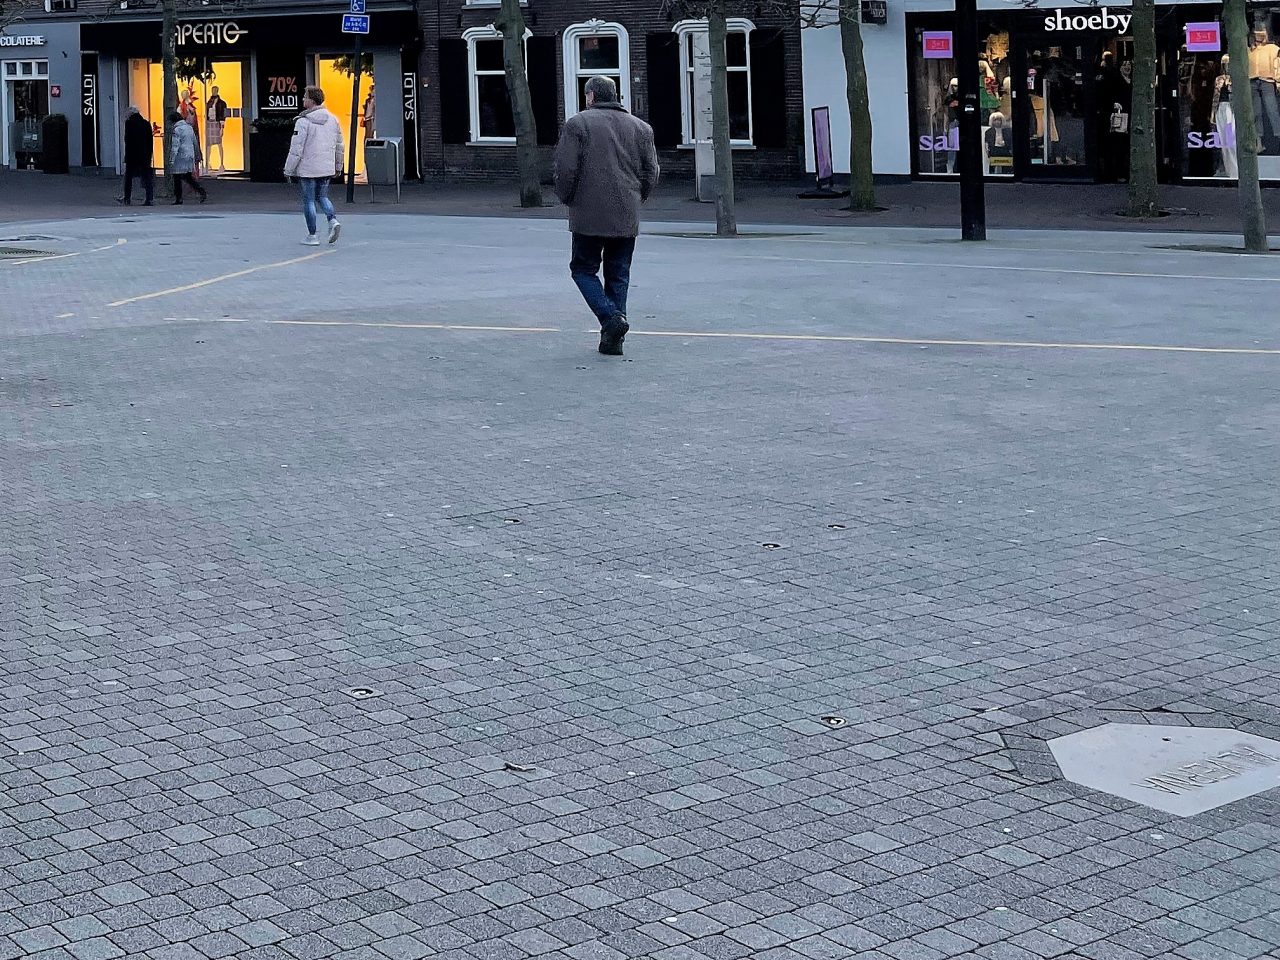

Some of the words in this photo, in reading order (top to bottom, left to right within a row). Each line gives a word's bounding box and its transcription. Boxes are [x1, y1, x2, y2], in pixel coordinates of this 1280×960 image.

[1044, 7, 1133, 34] shoeby
[83, 74, 94, 116] SALDI
[268, 76, 298, 93] 70%
[403, 72, 415, 121] SALDI
[268, 95, 298, 107] SALDI
[919, 126, 960, 151] sal
[1186, 122, 1235, 149] sal
